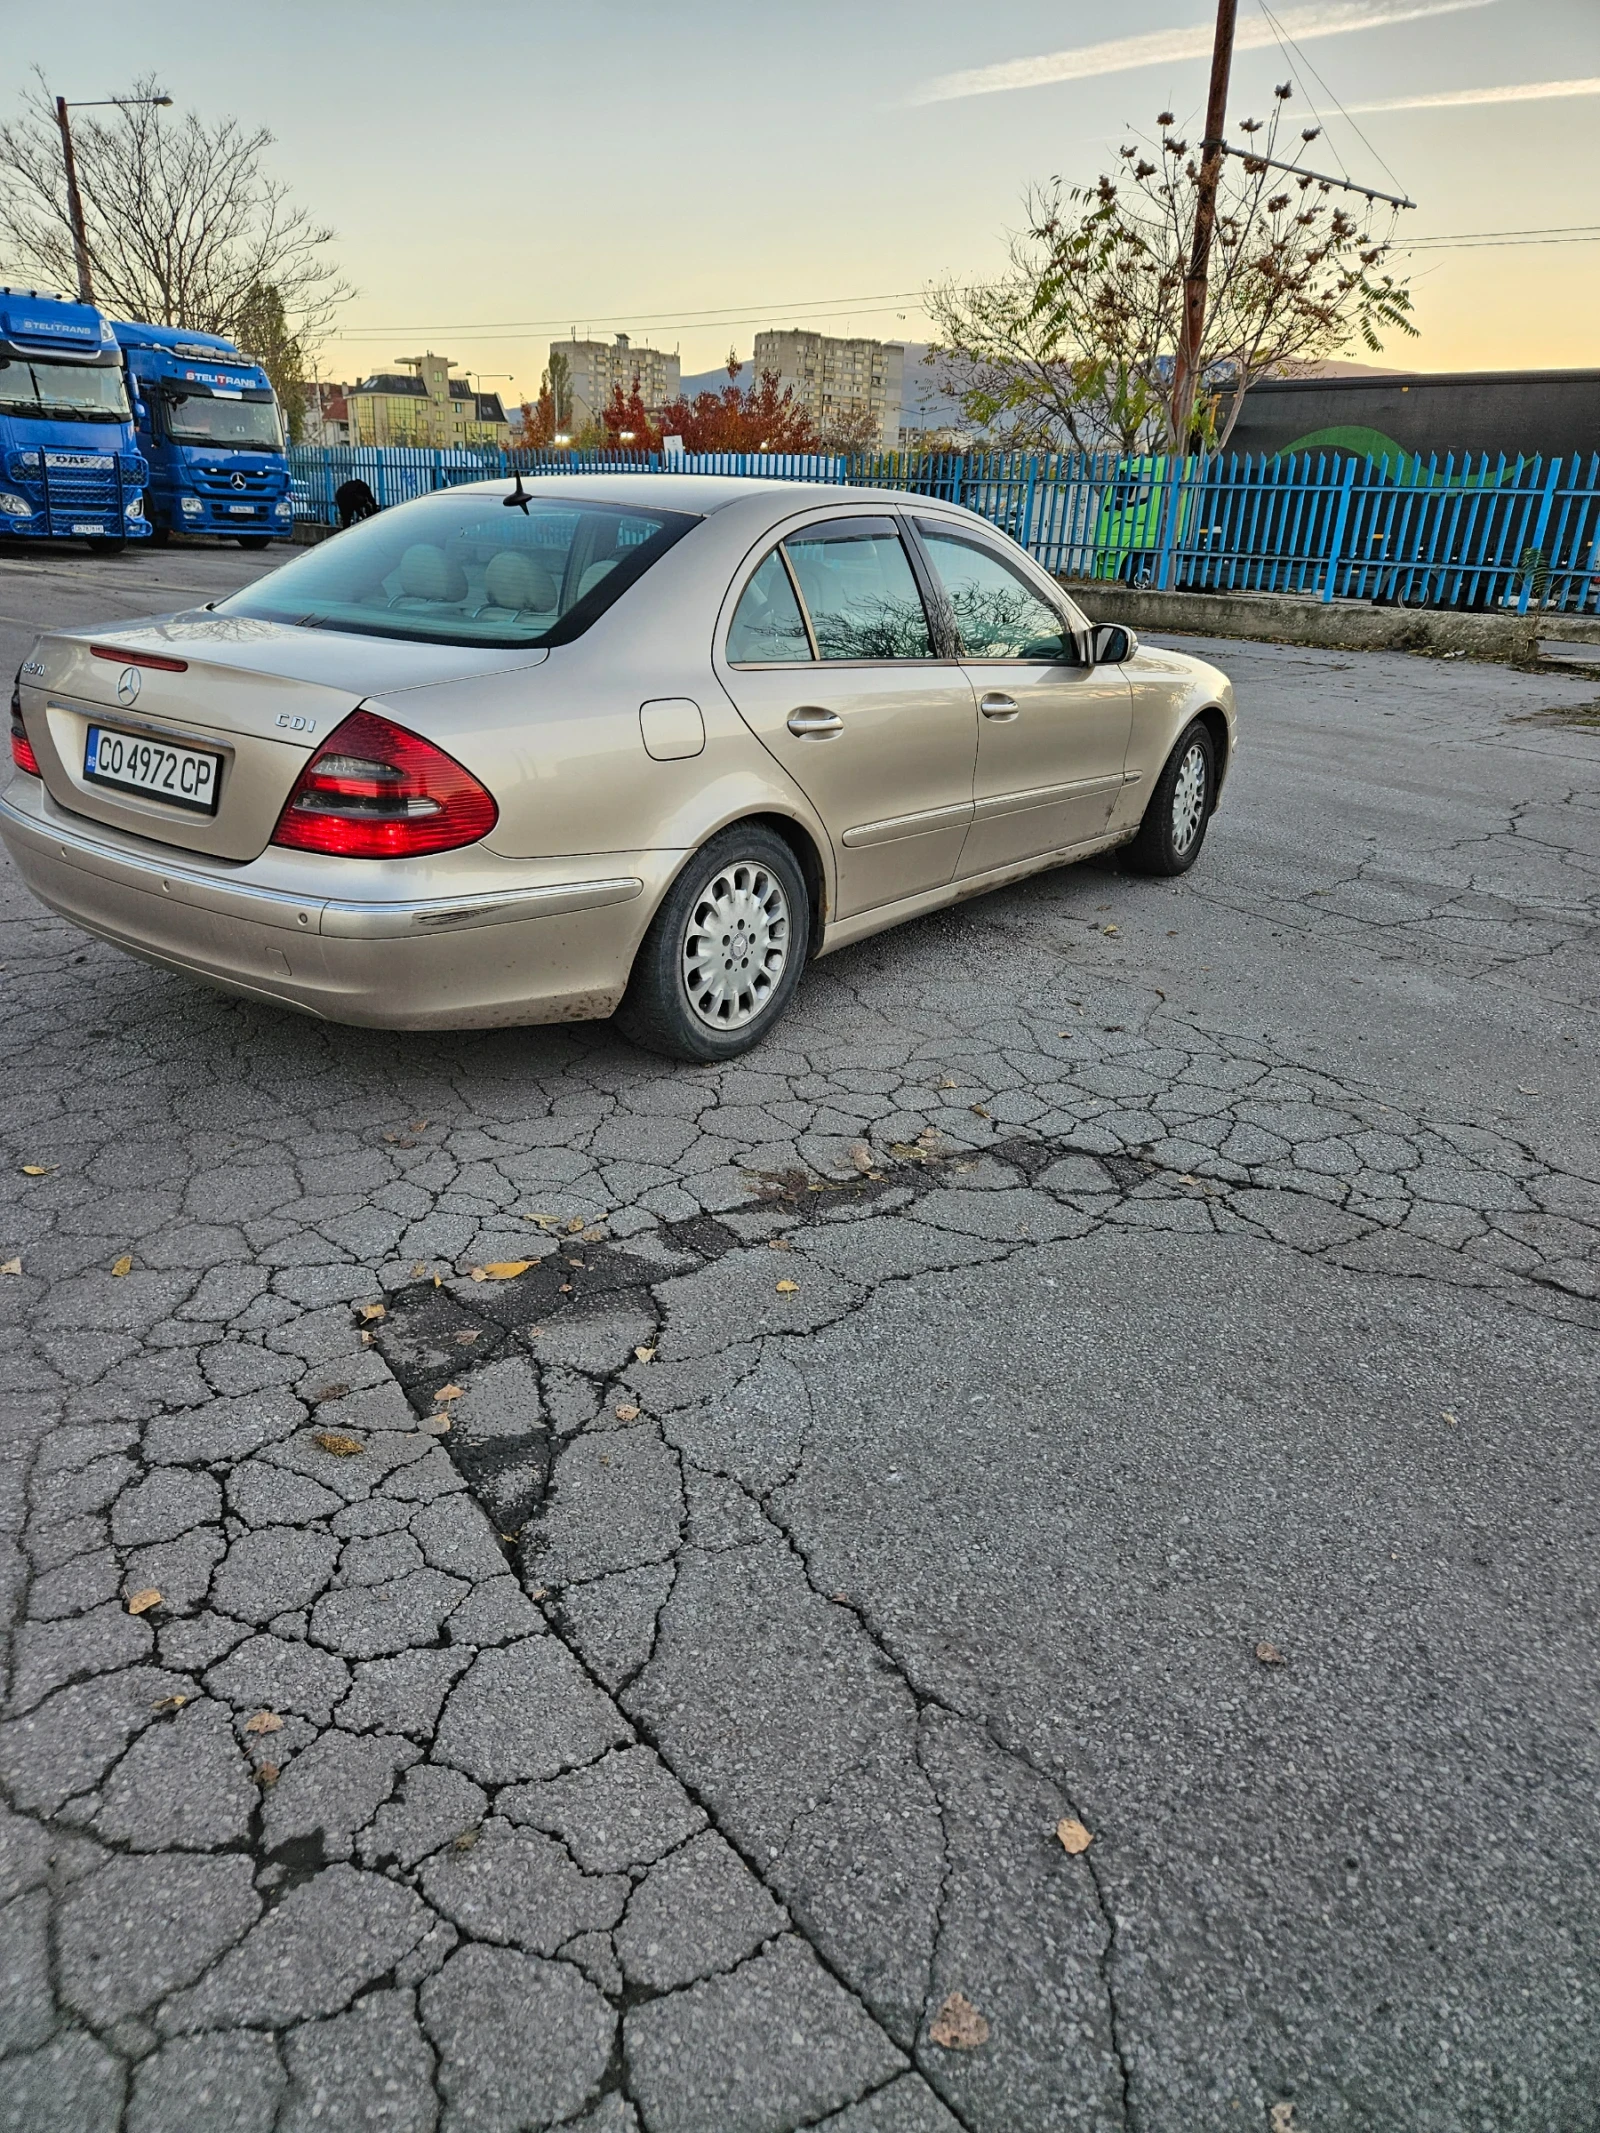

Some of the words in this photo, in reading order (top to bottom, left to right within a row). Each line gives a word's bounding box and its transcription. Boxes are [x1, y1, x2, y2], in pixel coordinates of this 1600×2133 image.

[24, 320, 91, 336] STELITRANS
[186, 372, 256, 387] STELITRANS
[56, 455, 90, 464] DAF
[275, 713, 317, 733] CDI
